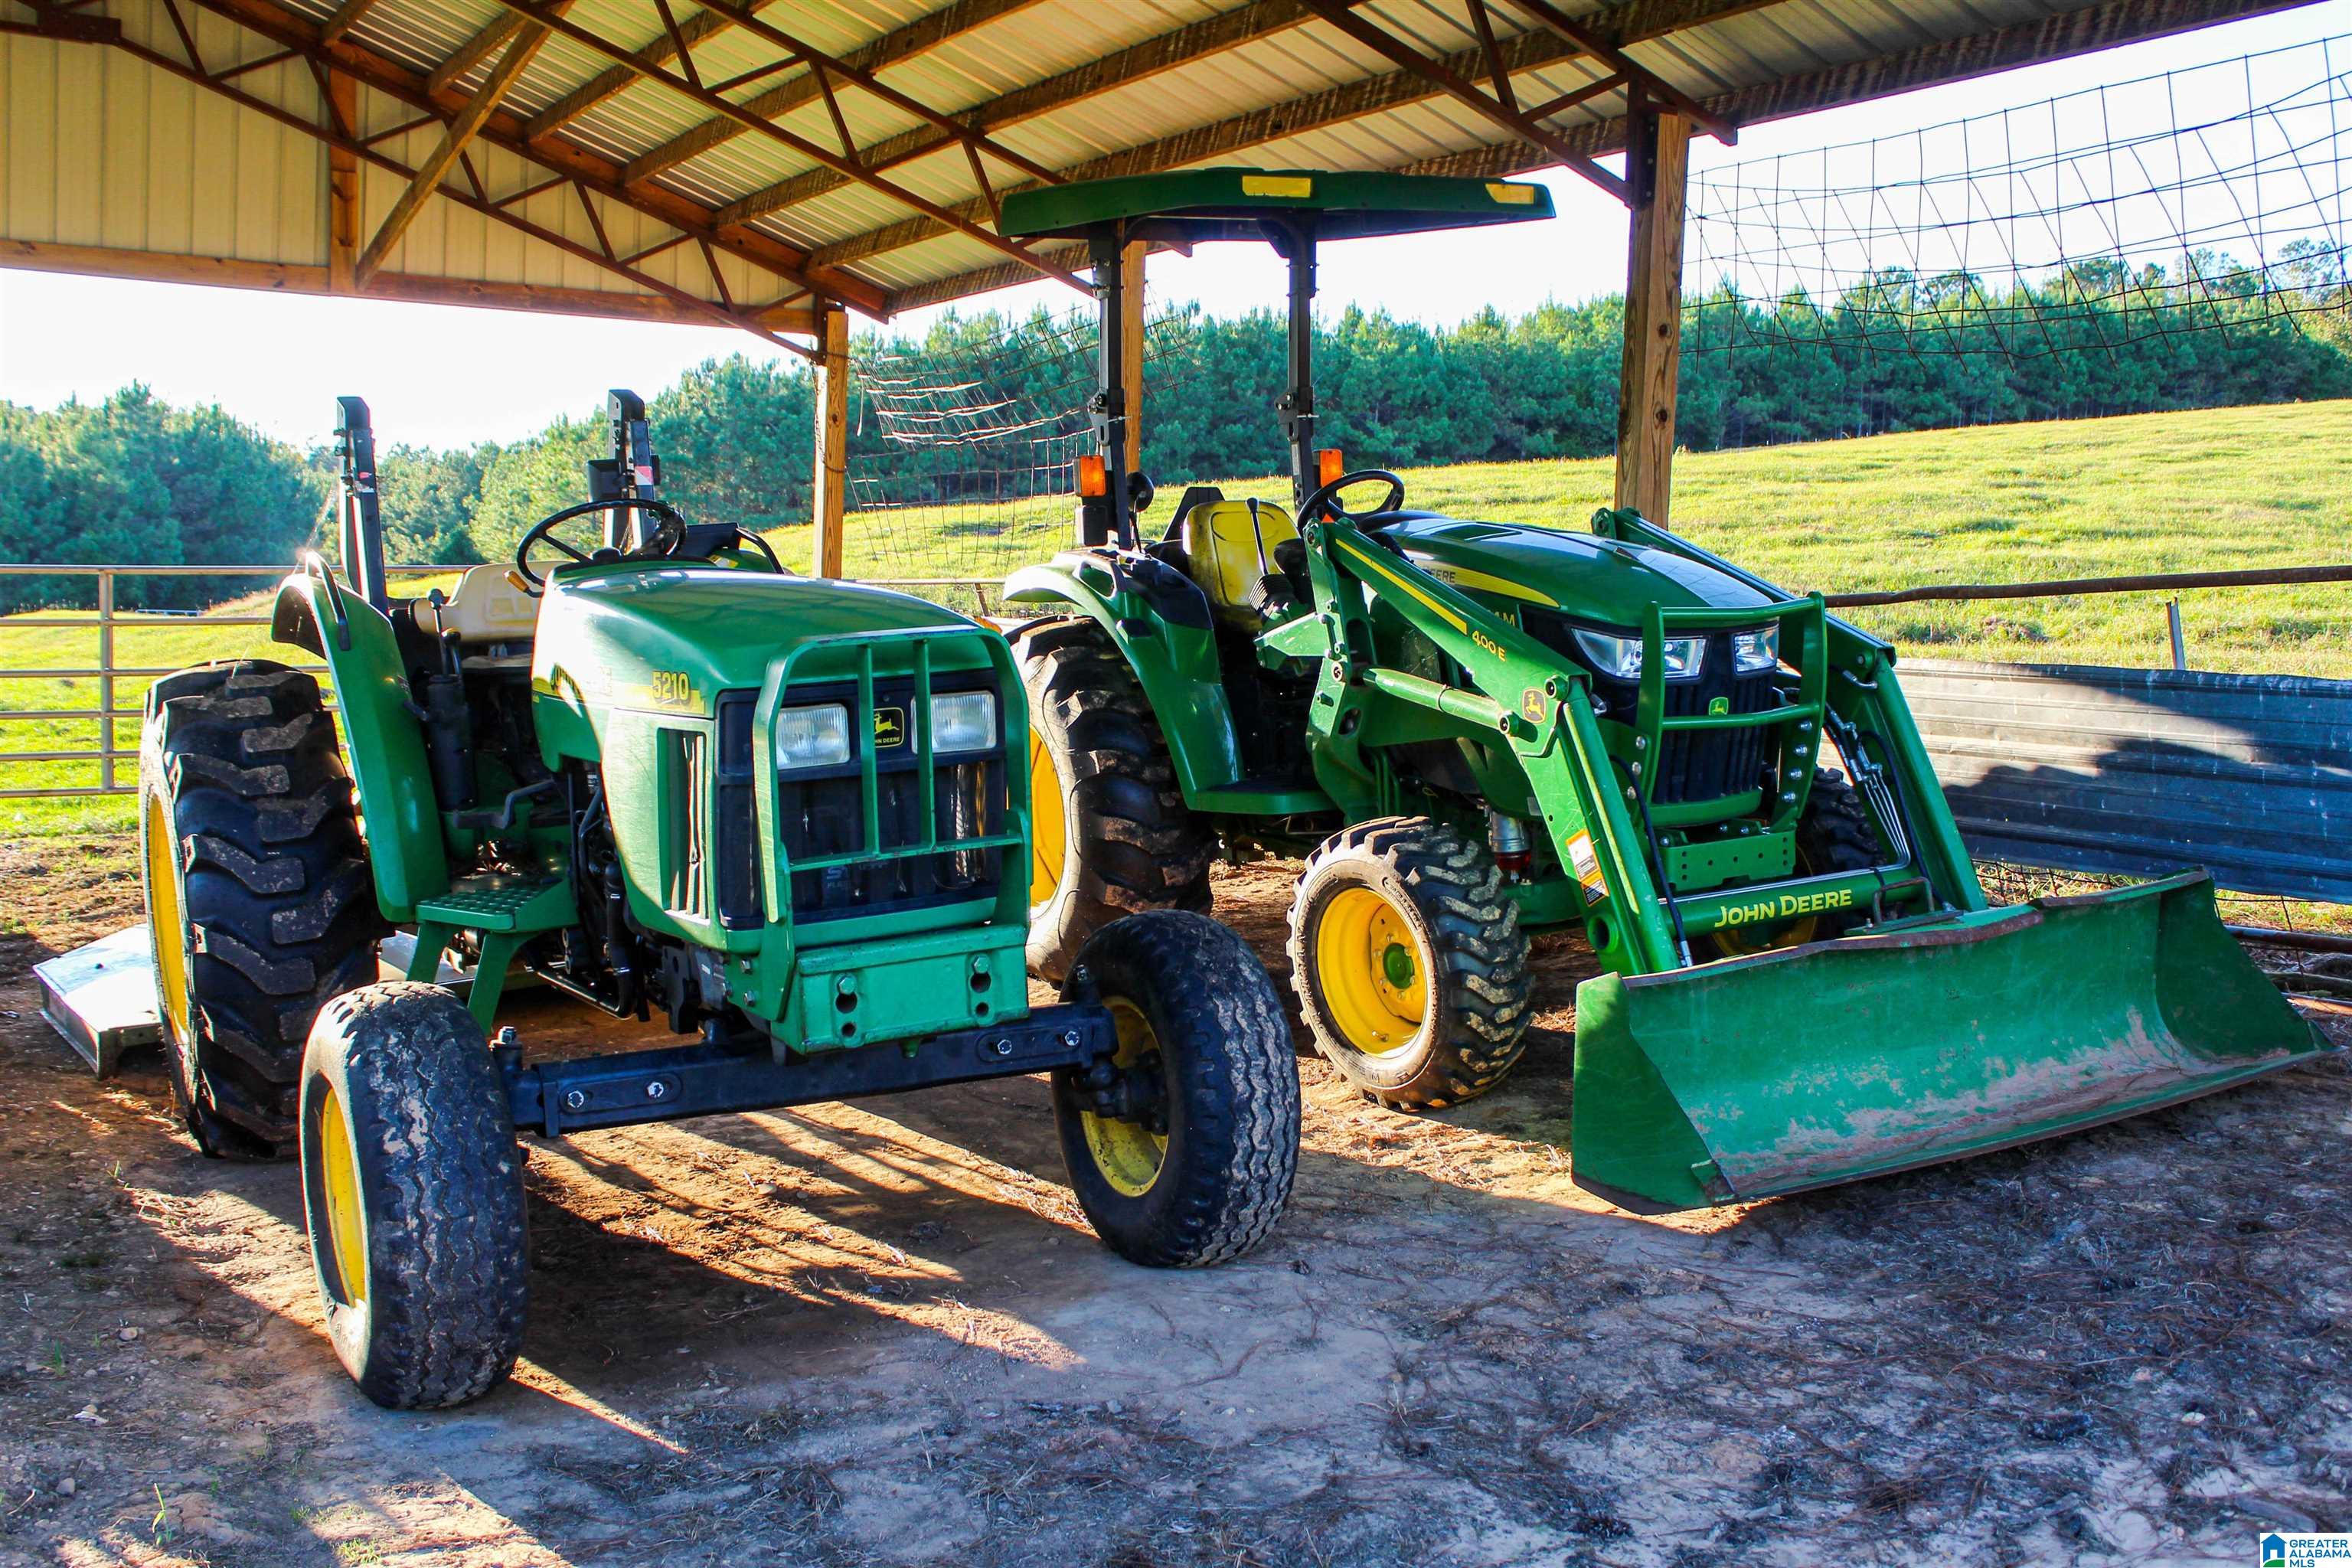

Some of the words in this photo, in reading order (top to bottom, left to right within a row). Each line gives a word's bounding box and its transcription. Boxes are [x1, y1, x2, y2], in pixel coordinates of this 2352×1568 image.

[652, 670, 689, 701] 5210
[1714, 901, 1775, 928] JOHN
[1779, 889, 1852, 916] DEERE
